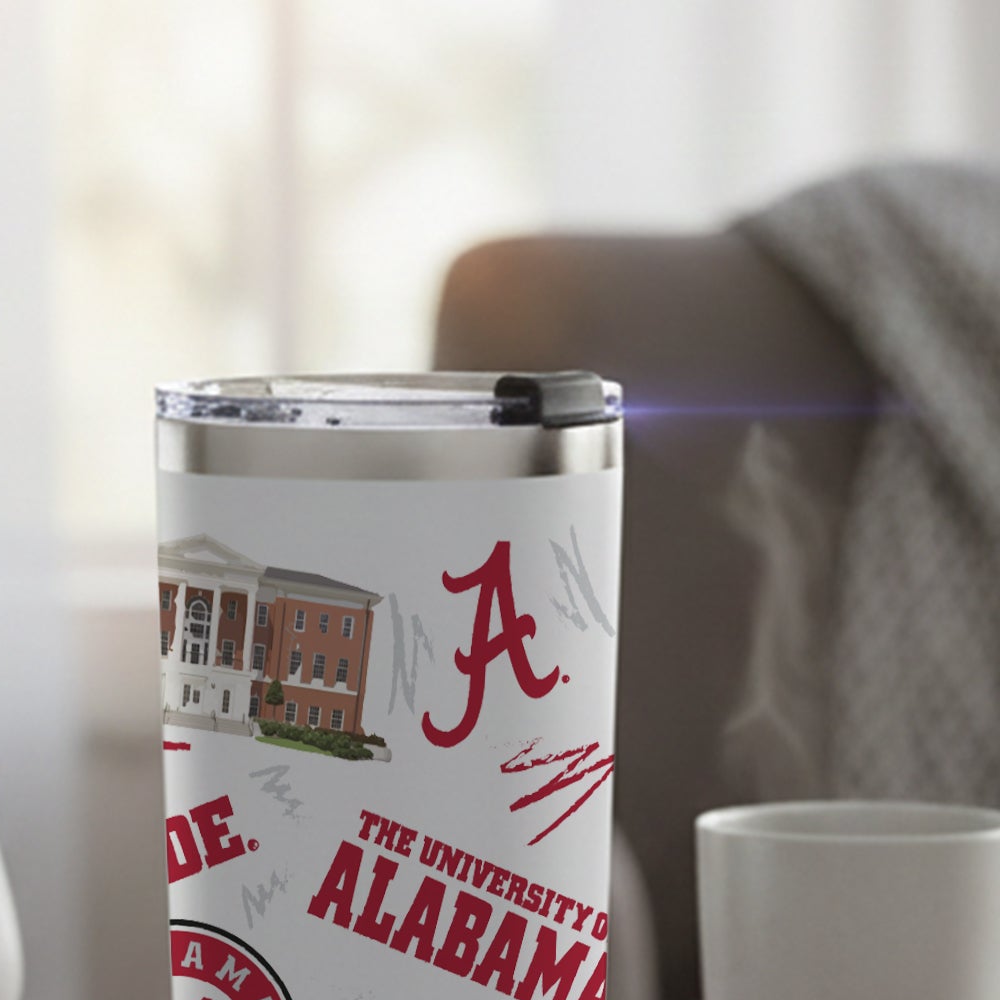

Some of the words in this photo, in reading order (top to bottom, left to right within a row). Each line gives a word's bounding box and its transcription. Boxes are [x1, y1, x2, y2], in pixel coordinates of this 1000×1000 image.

[422, 541, 560, 748] A
[358, 809, 418, 857] THE
[419, 835, 594, 933] UNIVERSITY
